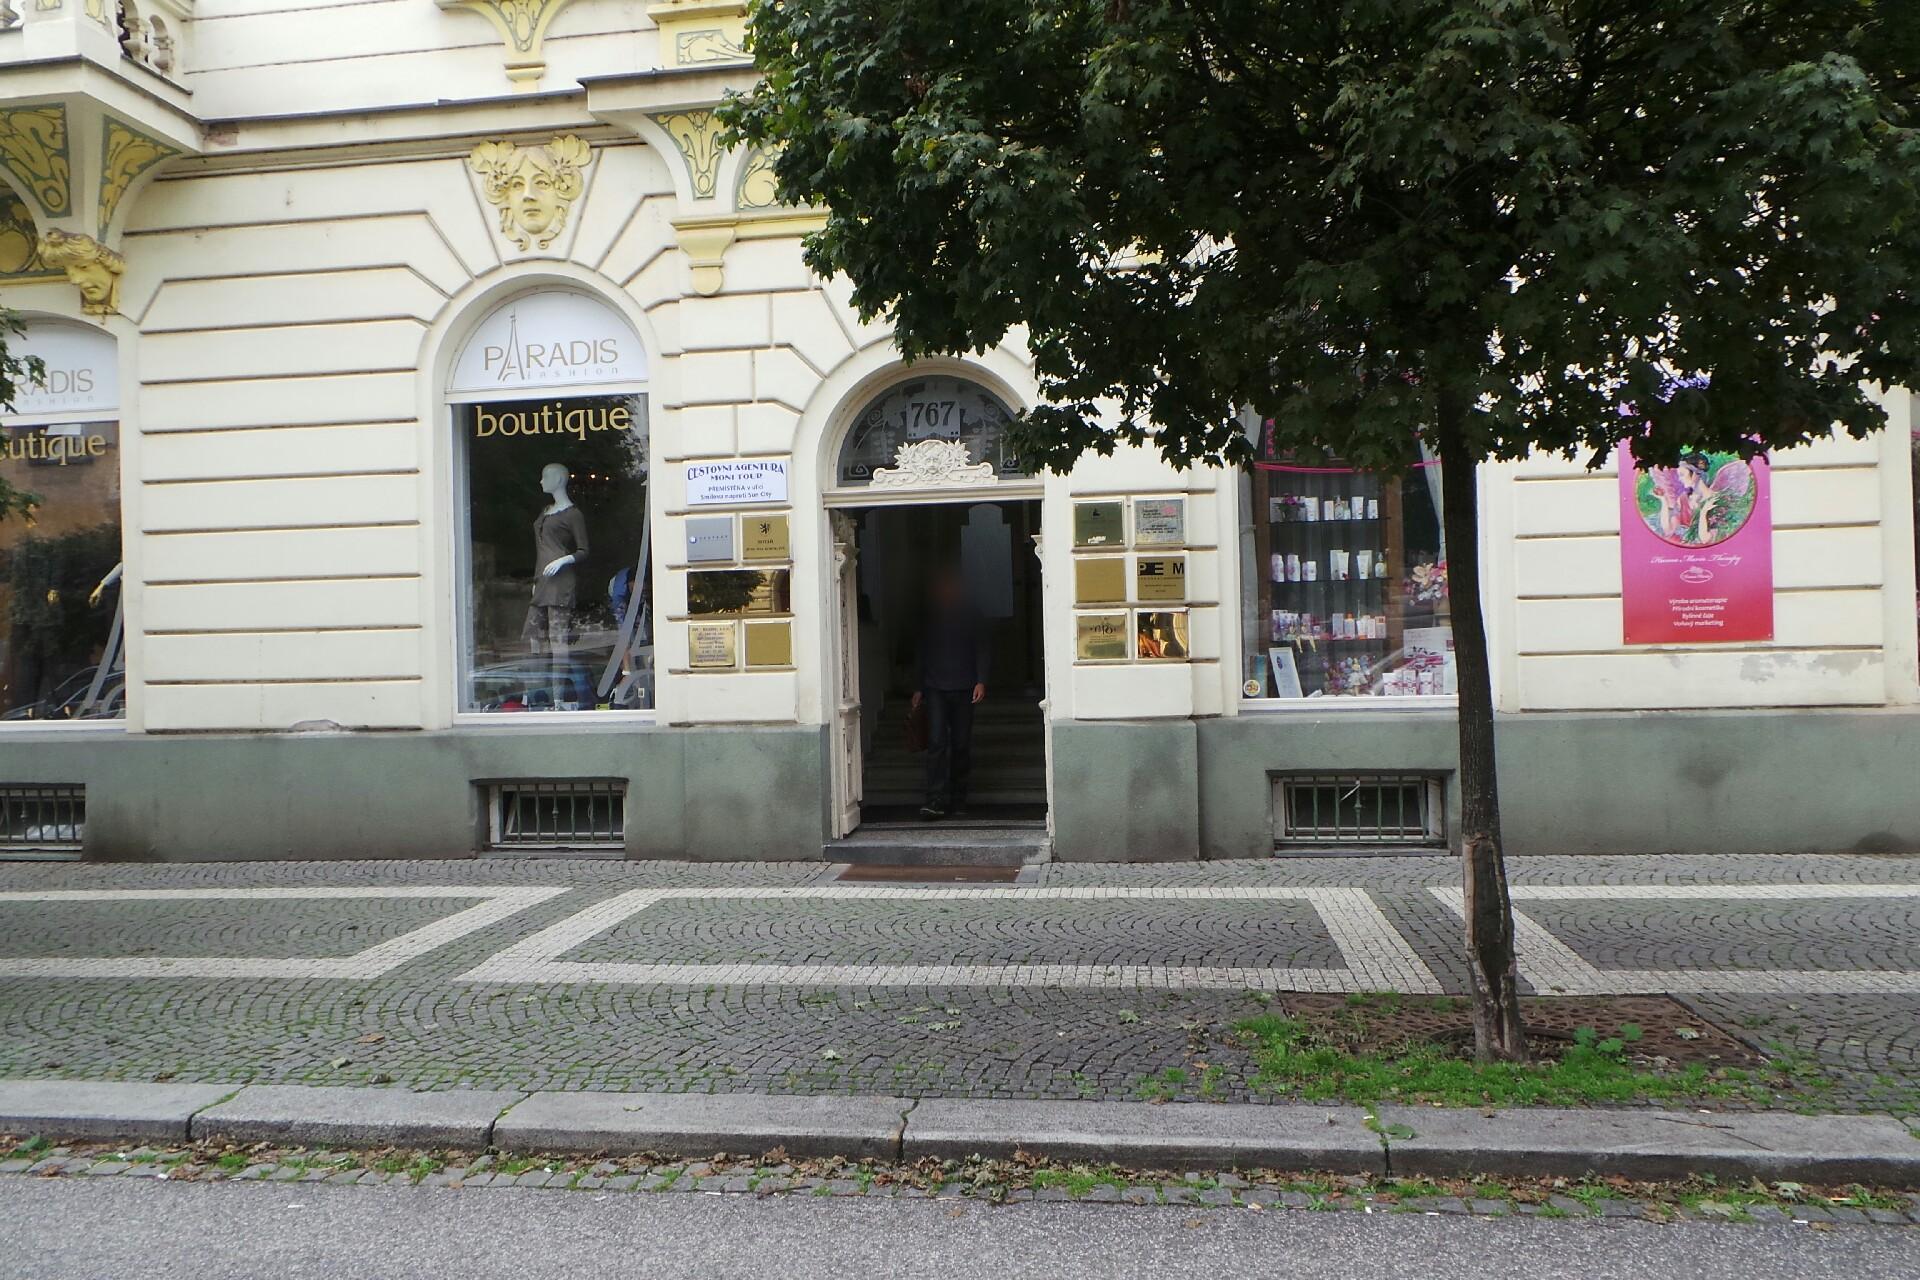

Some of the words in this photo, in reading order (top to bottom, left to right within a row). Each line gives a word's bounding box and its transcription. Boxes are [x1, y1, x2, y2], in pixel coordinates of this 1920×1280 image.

[484, 326, 618, 381] PARADIS
[13, 369, 94, 396] RADIS
[475, 403, 630, 440] boutique
[911, 401, 956, 428] 767
[0, 429, 106, 465] utique
[735, 463, 784, 475] AGENTURA
